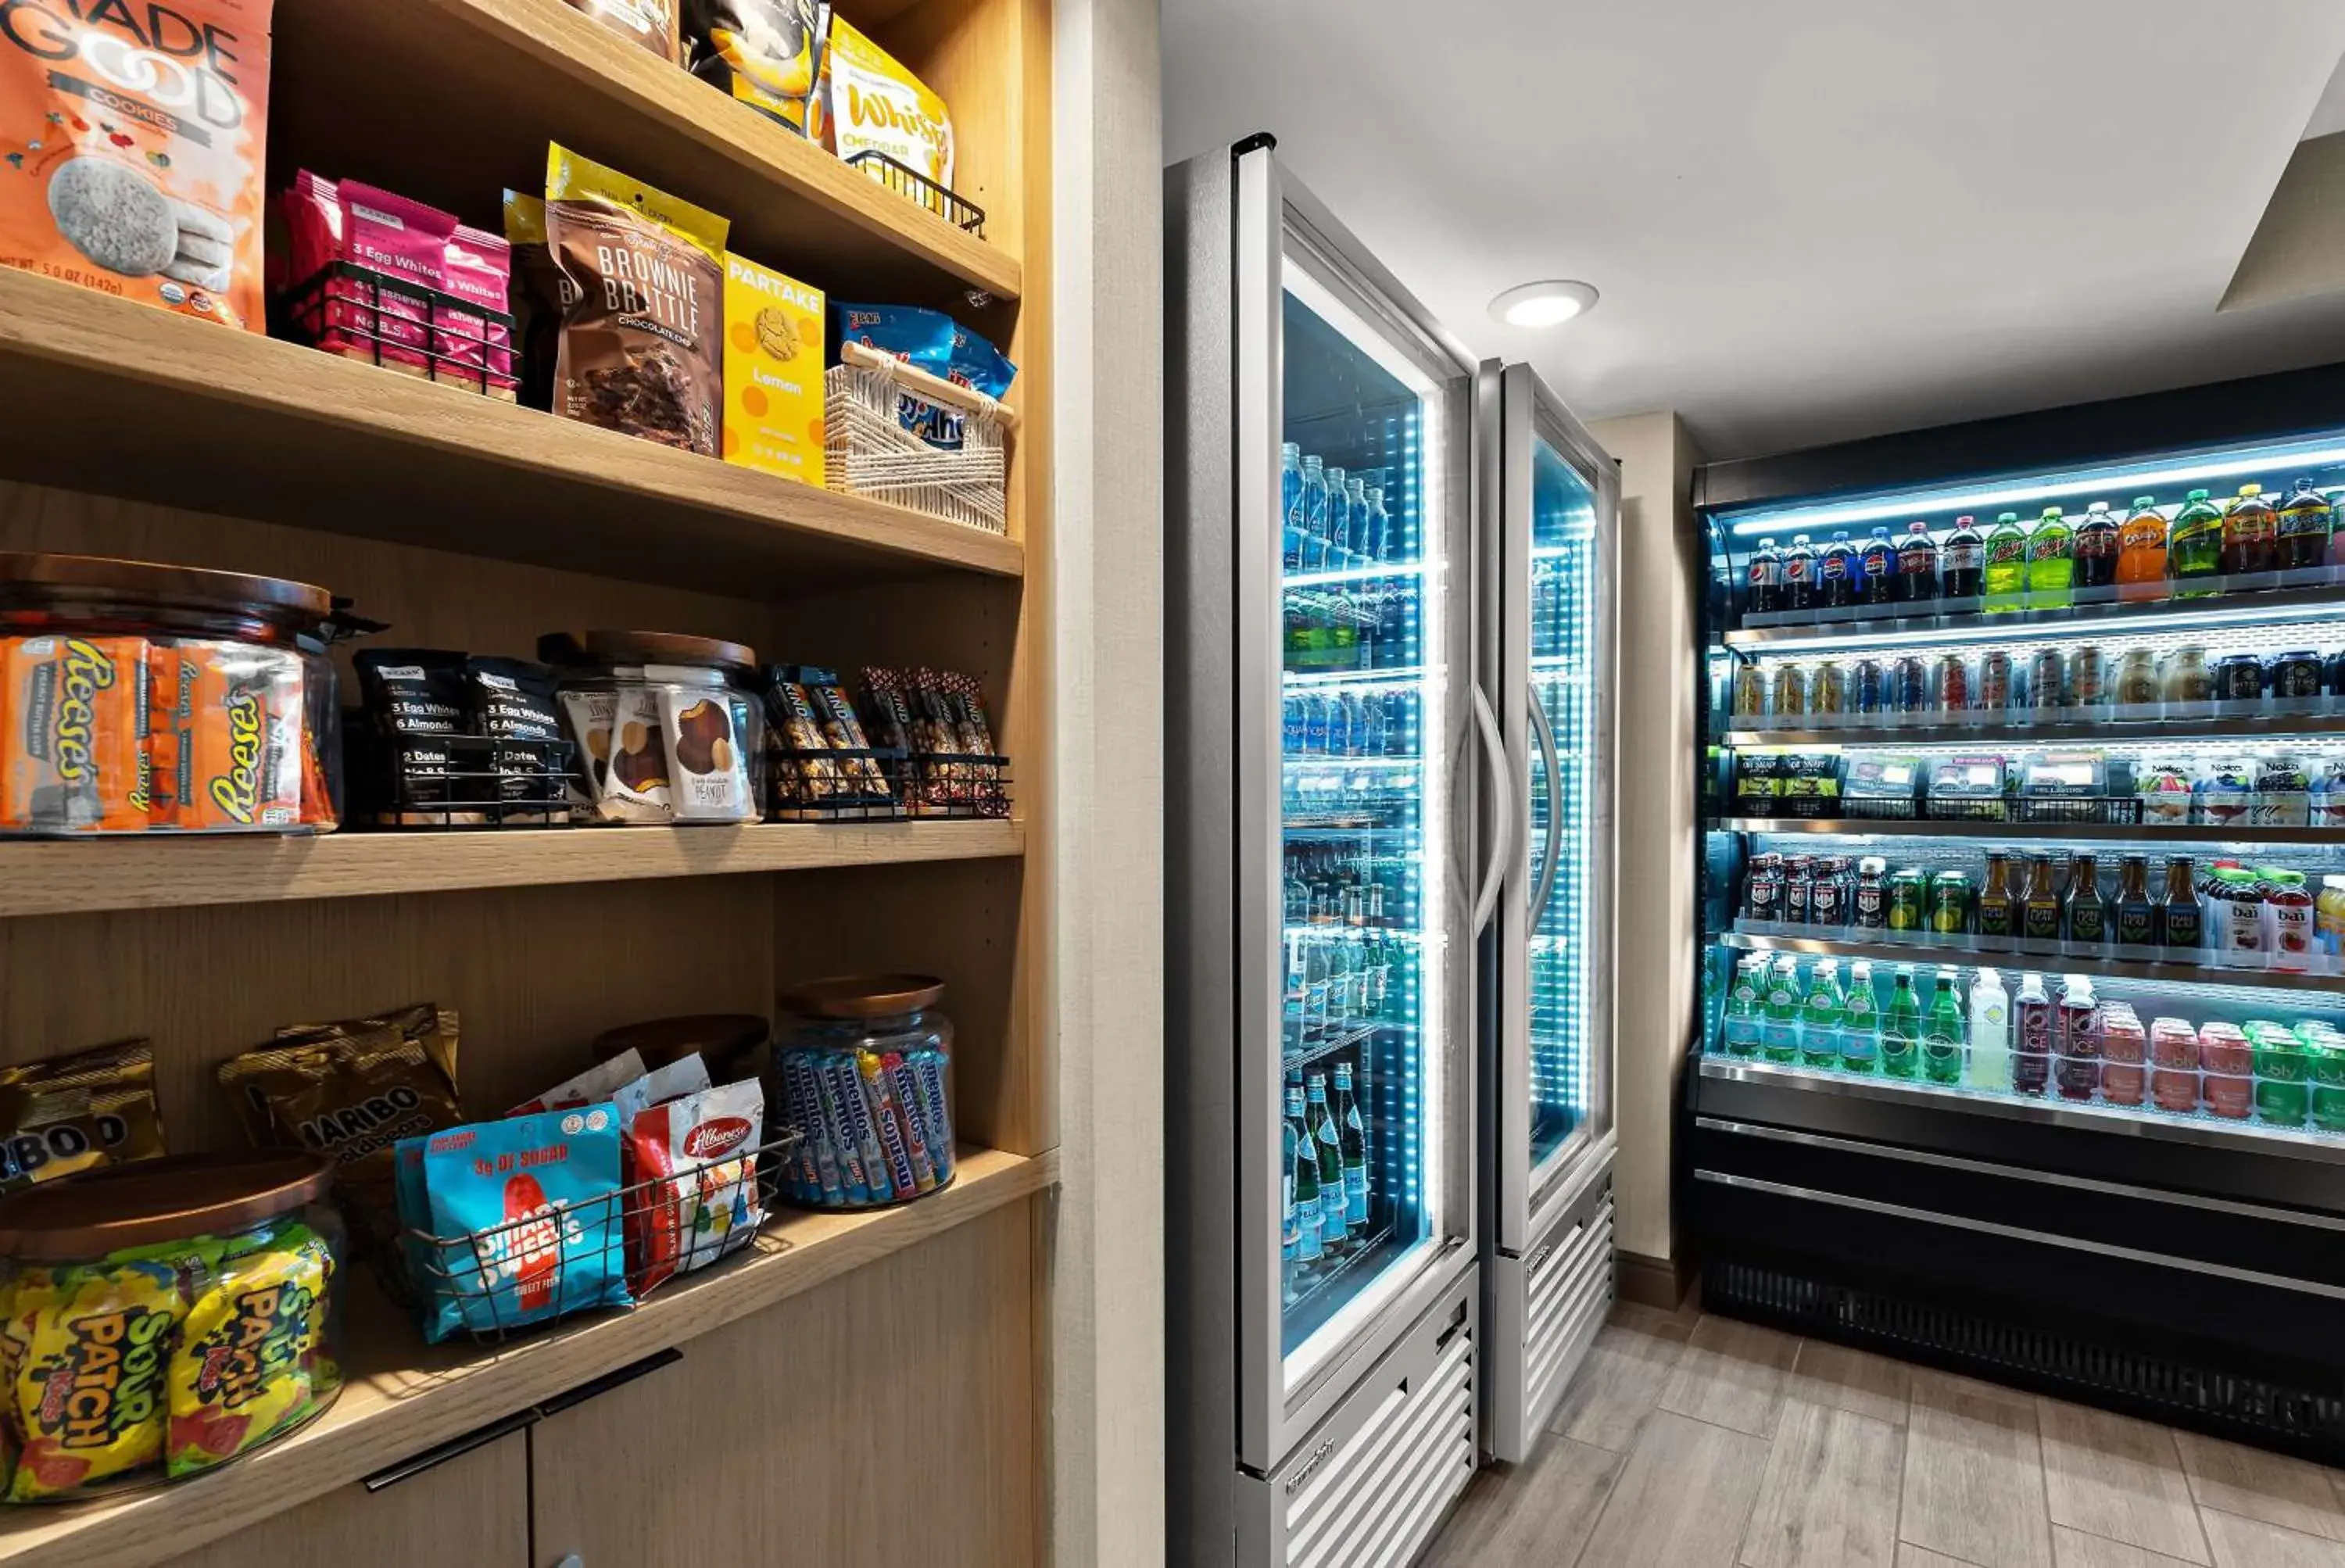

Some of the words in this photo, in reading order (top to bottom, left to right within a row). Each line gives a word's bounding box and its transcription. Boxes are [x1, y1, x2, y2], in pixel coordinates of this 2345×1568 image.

[66, 0, 238, 85] ADE
[0, 0, 242, 130] GOOD
[88, 88, 177, 131] COOKIES
[353, 242, 363, 255] 3
[366, 246, 392, 265] Egg
[395, 254, 442, 280] Whites
[597, 245, 698, 307] BROWNIE
[367, 283, 428, 310] Cshews
[729, 261, 821, 313] PARTAKE
[355, 315, 375, 330] No
[603, 277, 699, 338] BRITTLE
[753, 367, 803, 396] Lemon
[57, 638, 116, 785] Reese's
[392, 703, 401, 713] 3
[403, 702, 425, 715] Egg
[488, 704, 497, 714] 3
[499, 704, 521, 717] Egg
[521, 707, 556, 724] Whites
[782, 682, 808, 718] KIND
[823, 685, 848, 720] KIND
[396, 719, 406, 729] 6
[407, 717, 454, 730] Almonds
[490, 720, 499, 730] 6
[502, 719, 547, 736] Almonds
[414, 751, 446, 761] Dates
[504, 751, 539, 761] Dates
[2232, 905, 2259, 918] bai
[2278, 909, 2305, 922] bai
[2025, 1035, 2046, 1048] ICE
[2073, 1040, 2094, 1053] ICE
[799, 1065, 825, 1140] mentos
[824, 1068, 857, 1151] mentos
[841, 1065, 870, 1140] mentos
[894, 1066, 925, 1147] mentos
[691, 1126, 746, 1154] Albanese
[879, 1108, 913, 1190] mentos
[474, 1158, 494, 1177] 3g
[497, 1152, 517, 1172] OF
[520, 1144, 568, 1168] SUGAR
[478, 1219, 584, 1289] SWEETS
[225, 1287, 281, 1408] PACH
[66, 1312, 125, 1446] PATCH
[111, 1312, 171, 1430] SOUR
[41, 1370, 75, 1423] Kids
